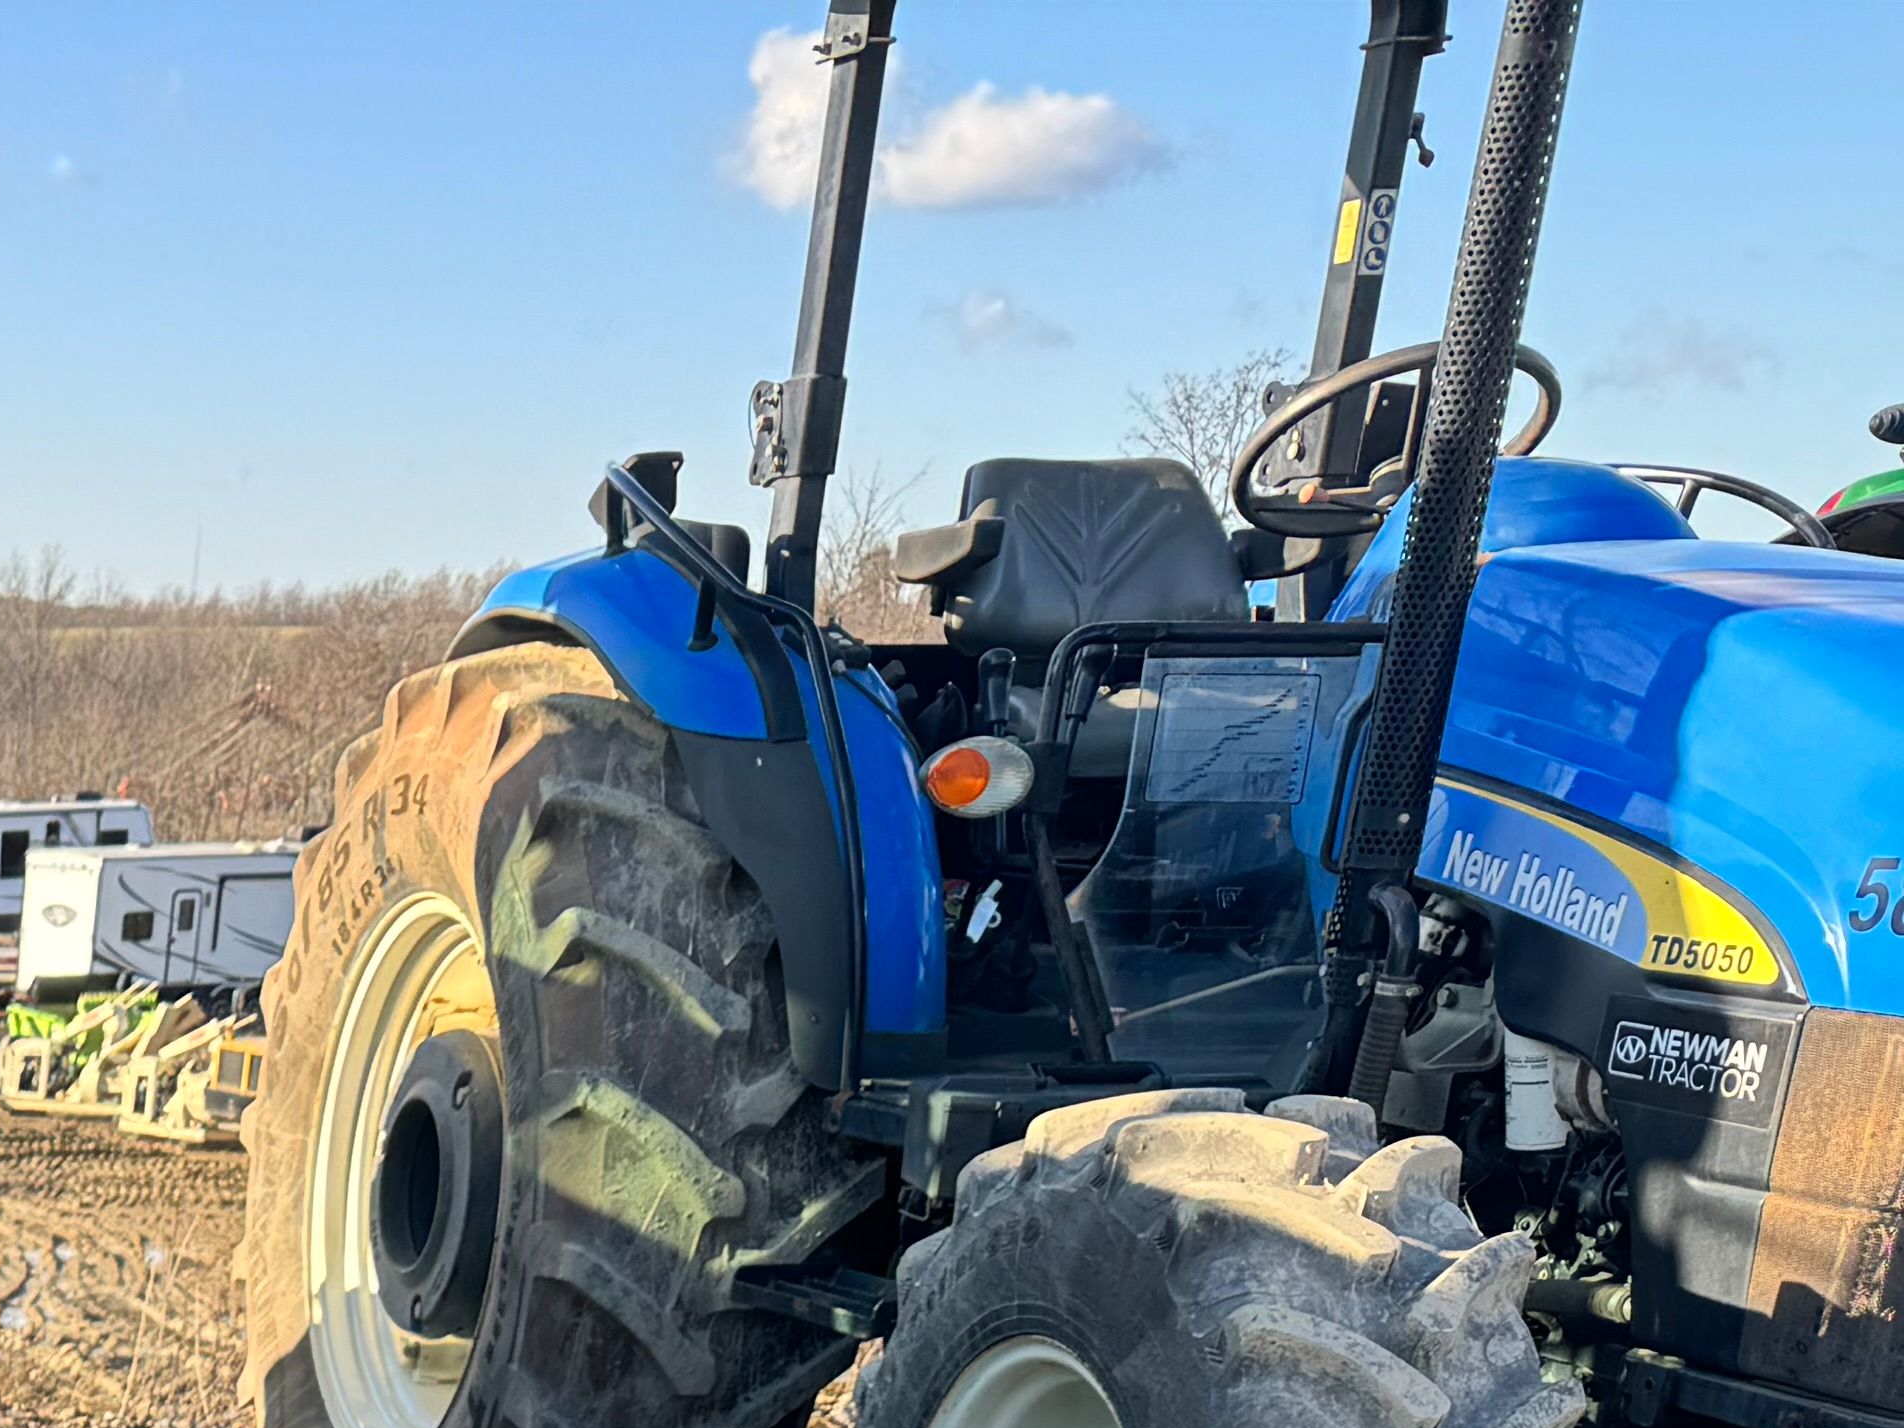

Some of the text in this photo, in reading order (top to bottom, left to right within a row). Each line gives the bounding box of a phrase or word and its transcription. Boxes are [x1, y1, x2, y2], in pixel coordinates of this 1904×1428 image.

[1442, 829, 1627, 948] New Holland
[1848, 856, 1904, 937] 5
[1650, 934, 1754, 975] TD5050
[1648, 1026, 1768, 1073] NEWMAN
[1647, 1054, 1760, 1102] TRACTOR
